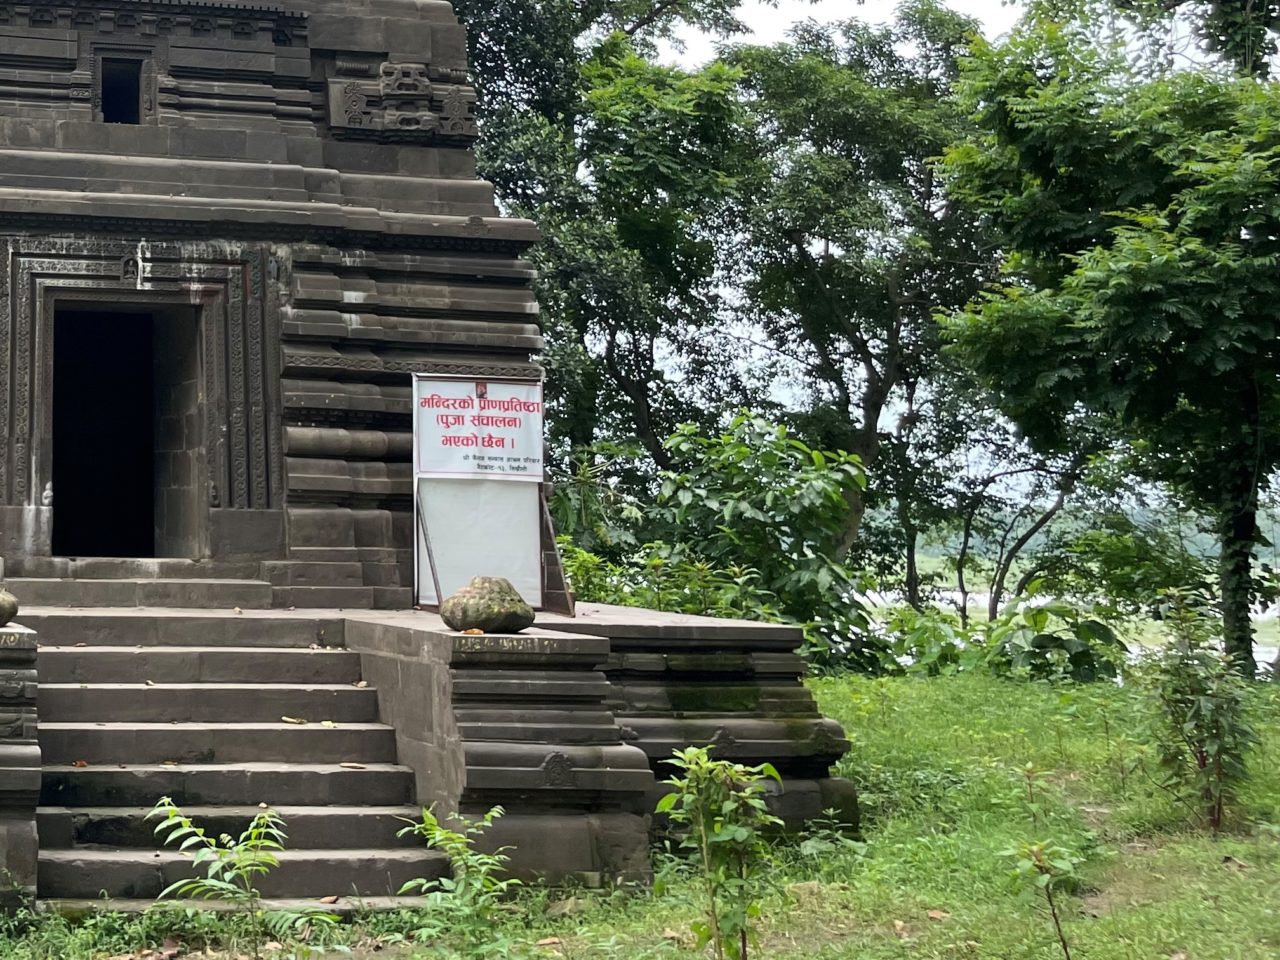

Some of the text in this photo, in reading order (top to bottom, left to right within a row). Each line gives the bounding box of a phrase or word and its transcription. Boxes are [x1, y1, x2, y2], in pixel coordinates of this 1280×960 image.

[420, 394, 540, 413] मन्दिरको प्राणप्रतिष्ठा
[436, 414, 522, 428] (पुजा संचालन)
[441, 434, 478, 447] भएको
[481, 433, 505, 448] छैन
